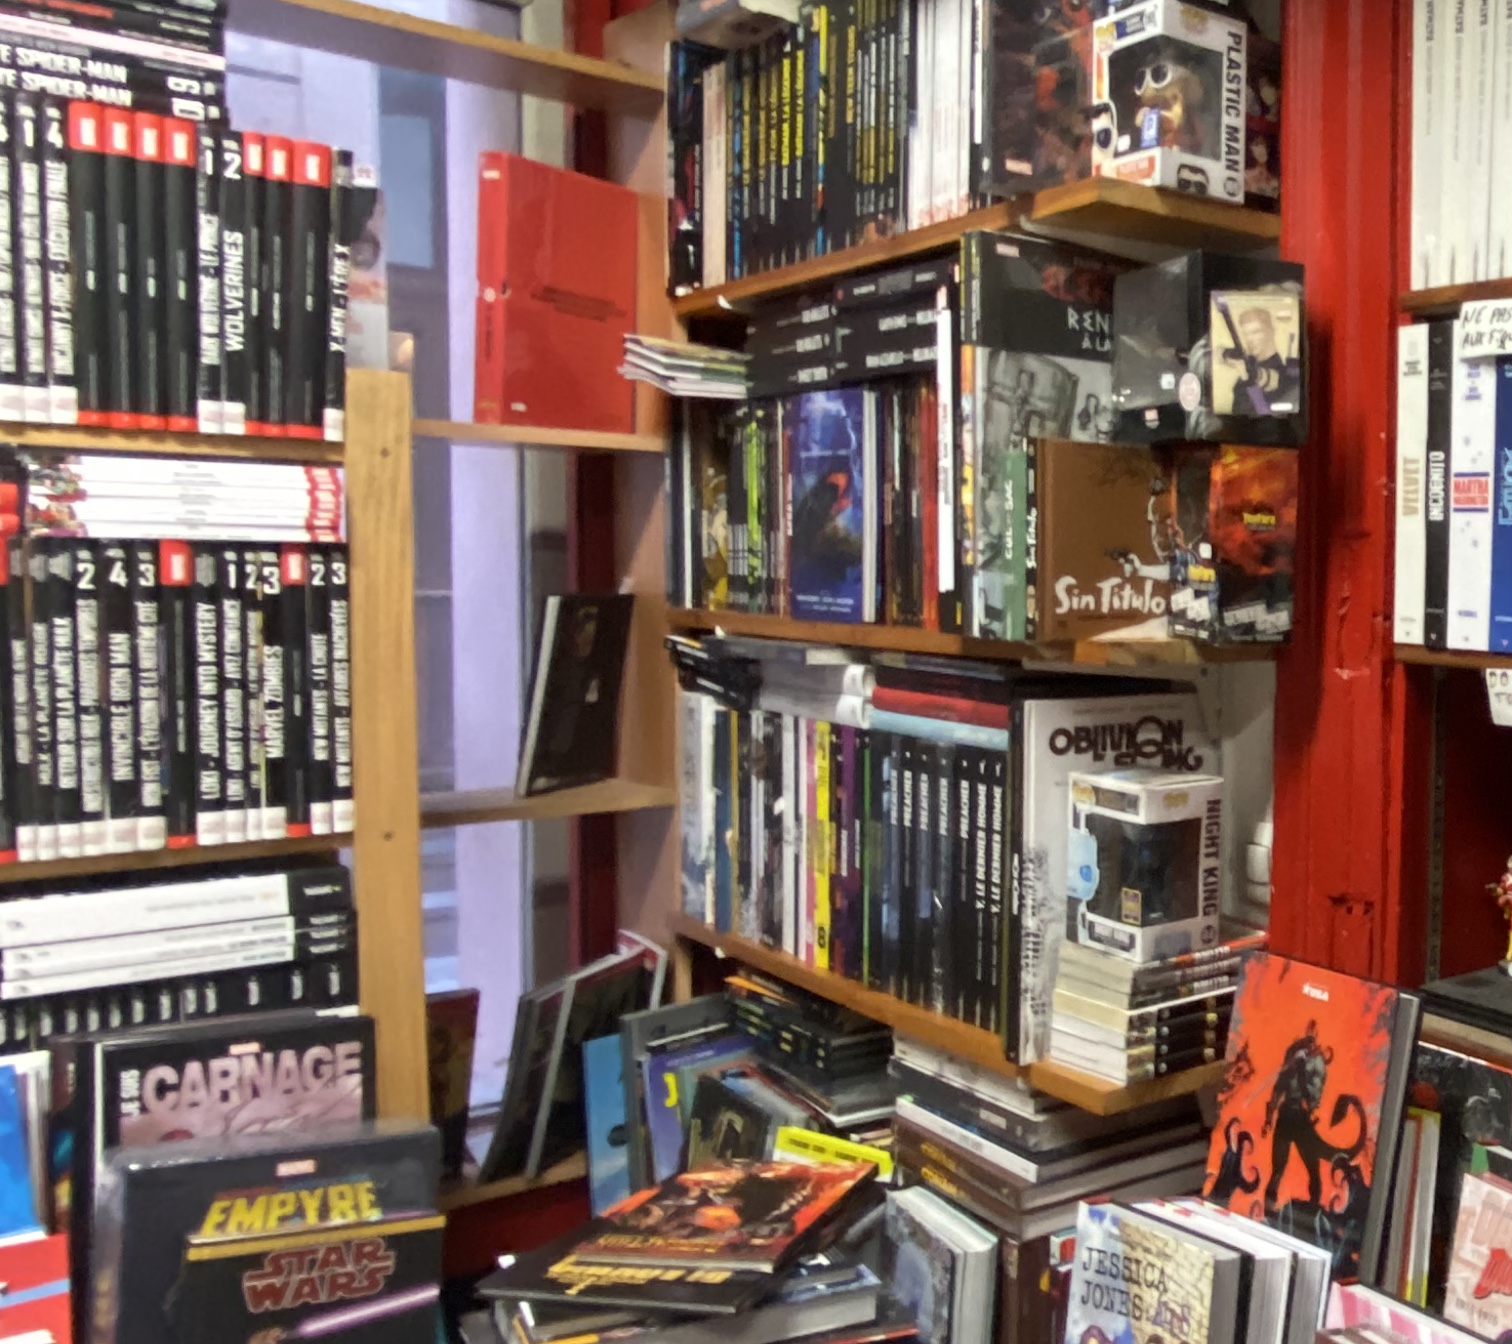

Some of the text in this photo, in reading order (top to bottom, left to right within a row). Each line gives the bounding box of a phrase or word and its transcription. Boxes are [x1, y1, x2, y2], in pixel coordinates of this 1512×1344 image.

[16, 47, 128, 84] SPIDER-MAN
[21, 71, 133, 107] SPIDER-MAN
[1224, 30, 1242, 172] PLASTIC MAN
[204, 149, 213, 176] 1
[222, 152, 242, 181] 2
[223, 229, 245, 353] WOLVERINES
[1462, 305, 1487, 328] NE
[1402, 457, 1420, 516] VELVET
[1429, 451, 1445, 521] INCOGNITO
[1453, 479, 1489, 495] MARTHA
[76, 563, 96, 591] 2
[108, 561, 129, 588] 4
[137, 562, 156, 587] 3
[262, 565, 281, 595] 3
[1054, 576, 1166, 615] Sin Titulo
[109, 666, 132, 702] IRON
[1489, 671, 1509, 689] DO
[262, 645, 284, 759] MARVEL ZOMBIES
[197, 665, 220, 800] LOKI JOURNEY INTO
[1203, 799, 1222, 917] NIGHT KING
[140, 1042, 362, 1116] CARNAGE
[200, 1180, 382, 1238] EMPYRE
[245, 1236, 397, 1284] STAR
[1082, 1247, 1169, 1294] JESSICA
[245, 1268, 393, 1314] WARS
[1080, 1279, 1143, 1320] JONES
